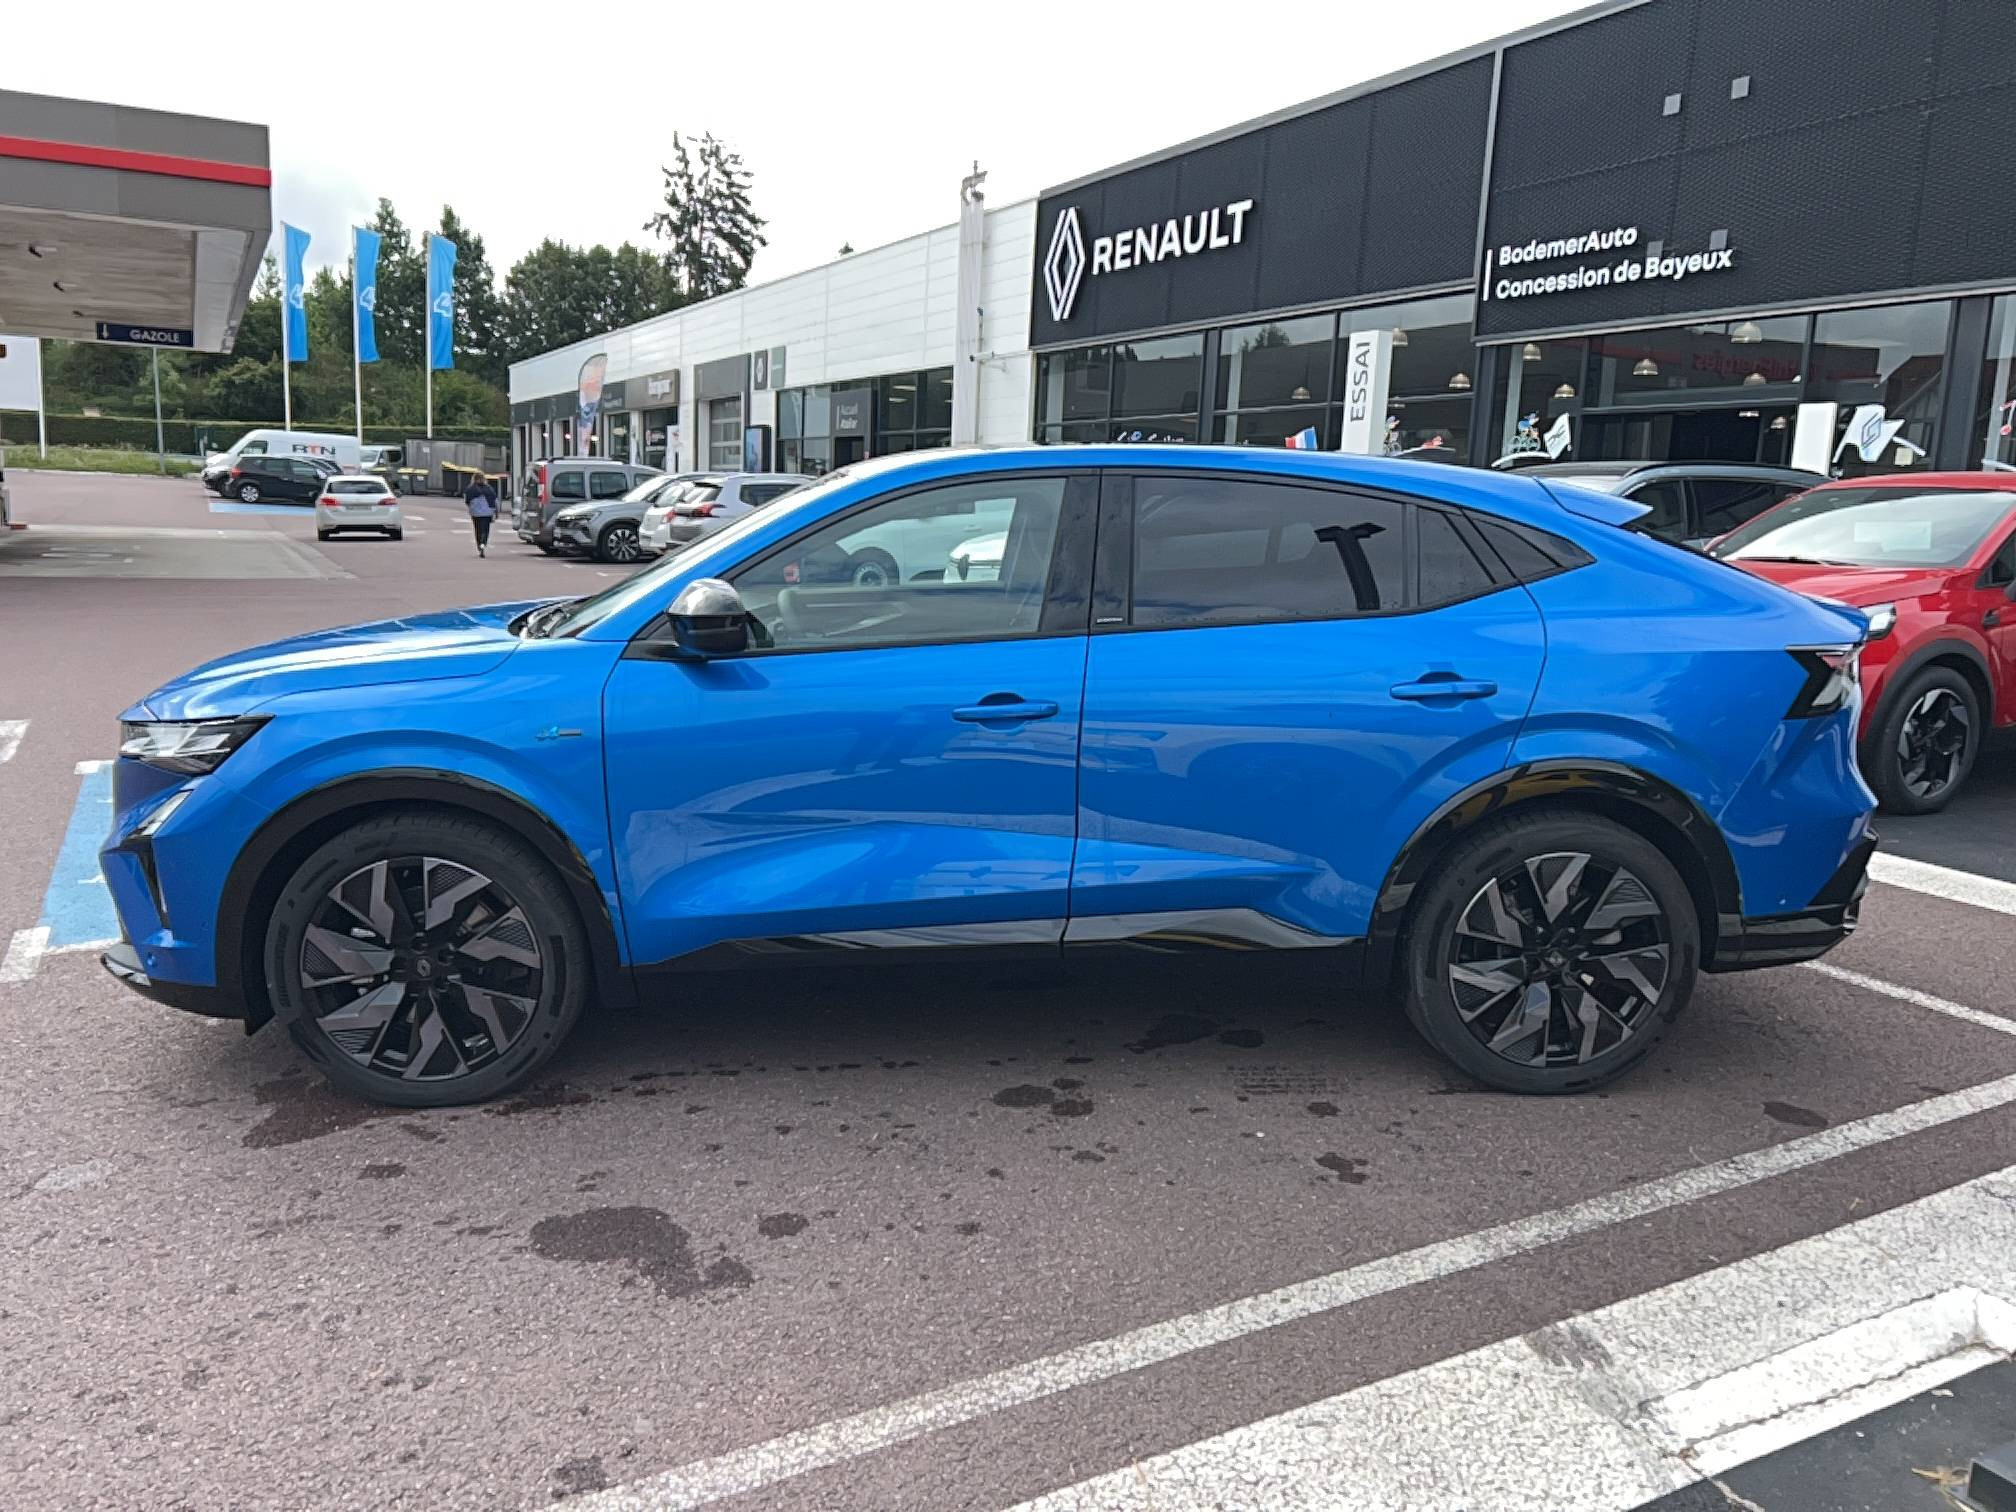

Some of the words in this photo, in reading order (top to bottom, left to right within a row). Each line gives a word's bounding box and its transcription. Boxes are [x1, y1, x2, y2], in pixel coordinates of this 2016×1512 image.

[1092, 199, 1253, 276] RENAULT
[1498, 226, 1639, 266] BodemerAuto
[1495, 264, 1610, 300] Concession
[1612, 258, 1642, 284] de
[1644, 248, 1734, 281] Bayeux
[129, 328, 180, 343] GAZOLE
[1350, 342, 1371, 422] ESSAI
[292, 443, 336, 455] RTN
